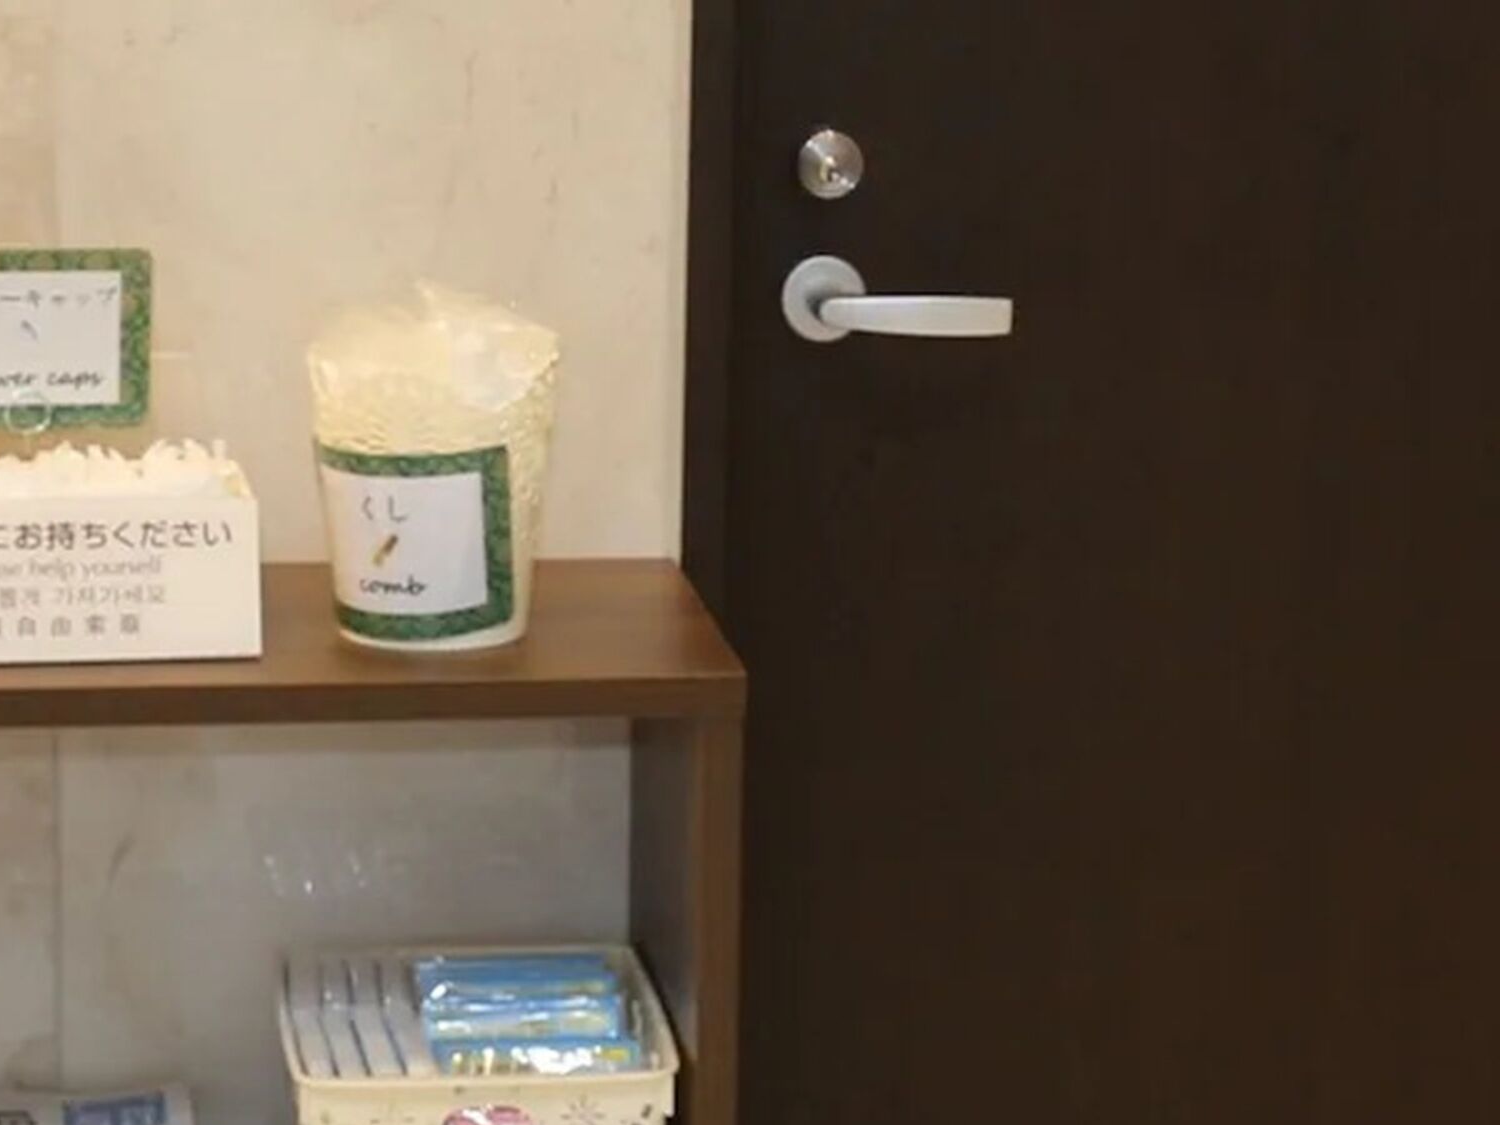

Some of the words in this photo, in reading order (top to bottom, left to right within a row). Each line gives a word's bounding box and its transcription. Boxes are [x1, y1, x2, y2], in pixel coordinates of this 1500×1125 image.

[46, 370, 104, 391] caps
[361, 496, 408, 522] くし
[28, 556, 75, 582] help
[80, 555, 162, 580] yourself
[359, 575, 427, 595] comb
